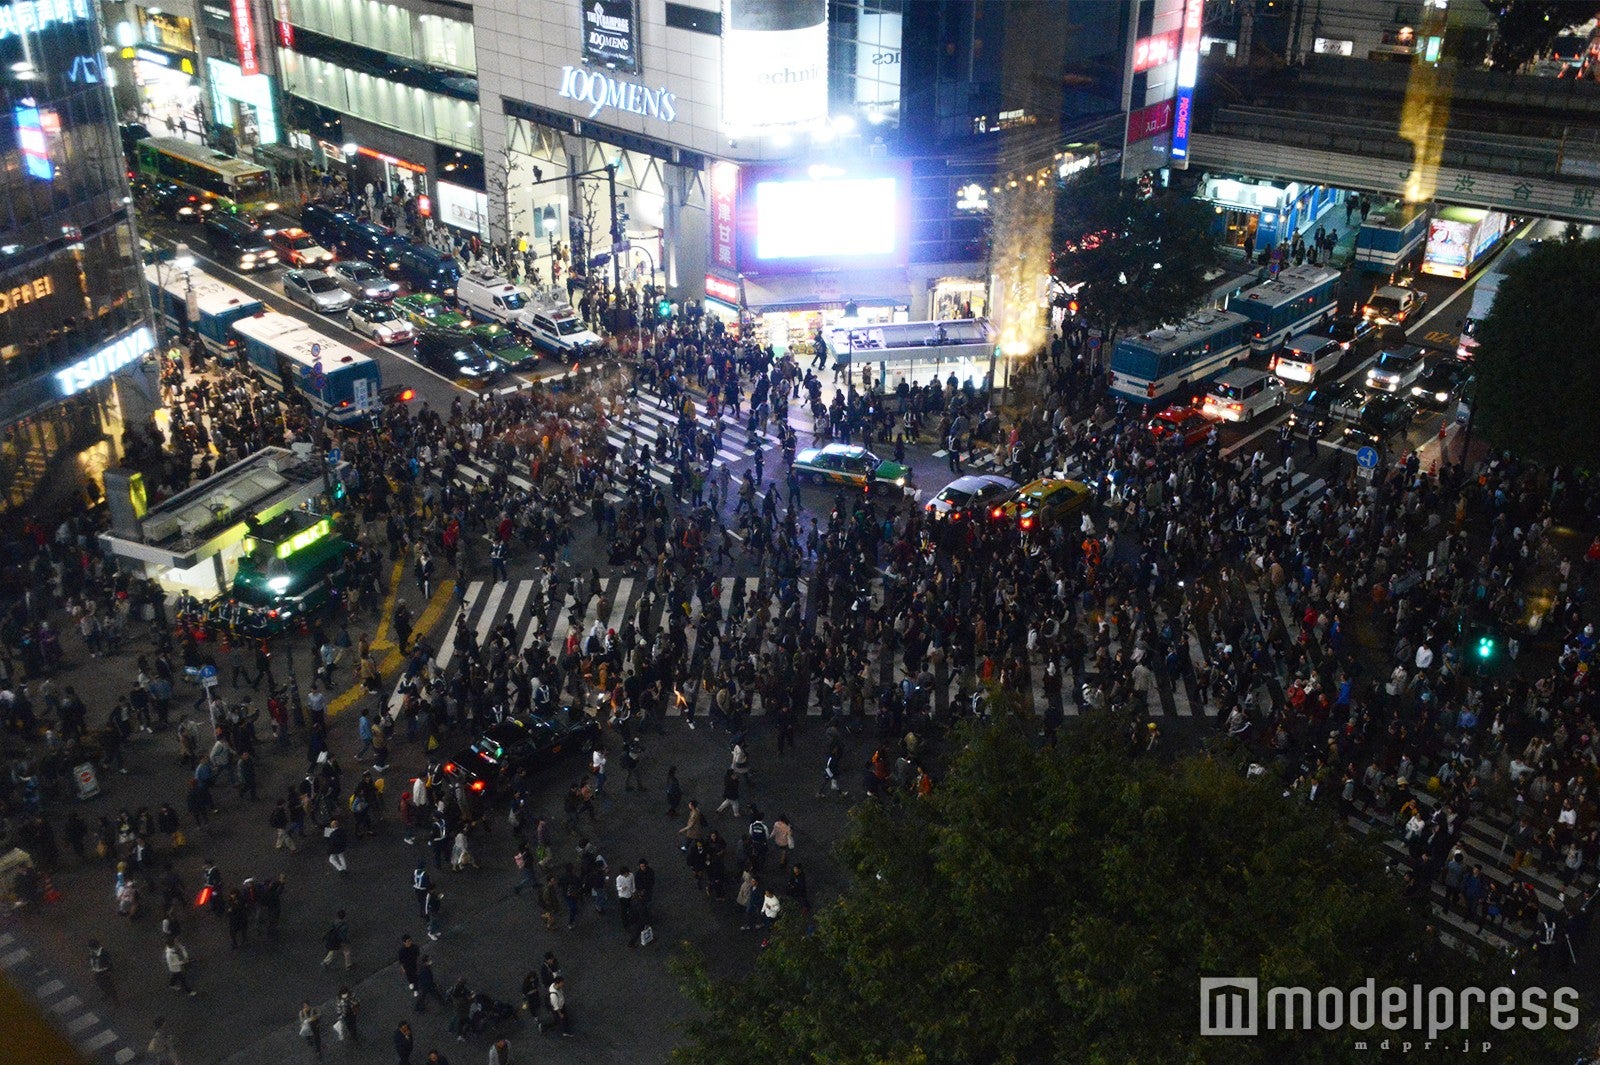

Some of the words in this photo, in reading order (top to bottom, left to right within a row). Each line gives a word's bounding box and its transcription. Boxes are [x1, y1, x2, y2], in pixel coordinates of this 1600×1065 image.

[558, 65, 677, 122] 109MEN'S
[1176, 97, 1190, 139] PROMISE
[55, 326, 155, 396] TSUTAYA
